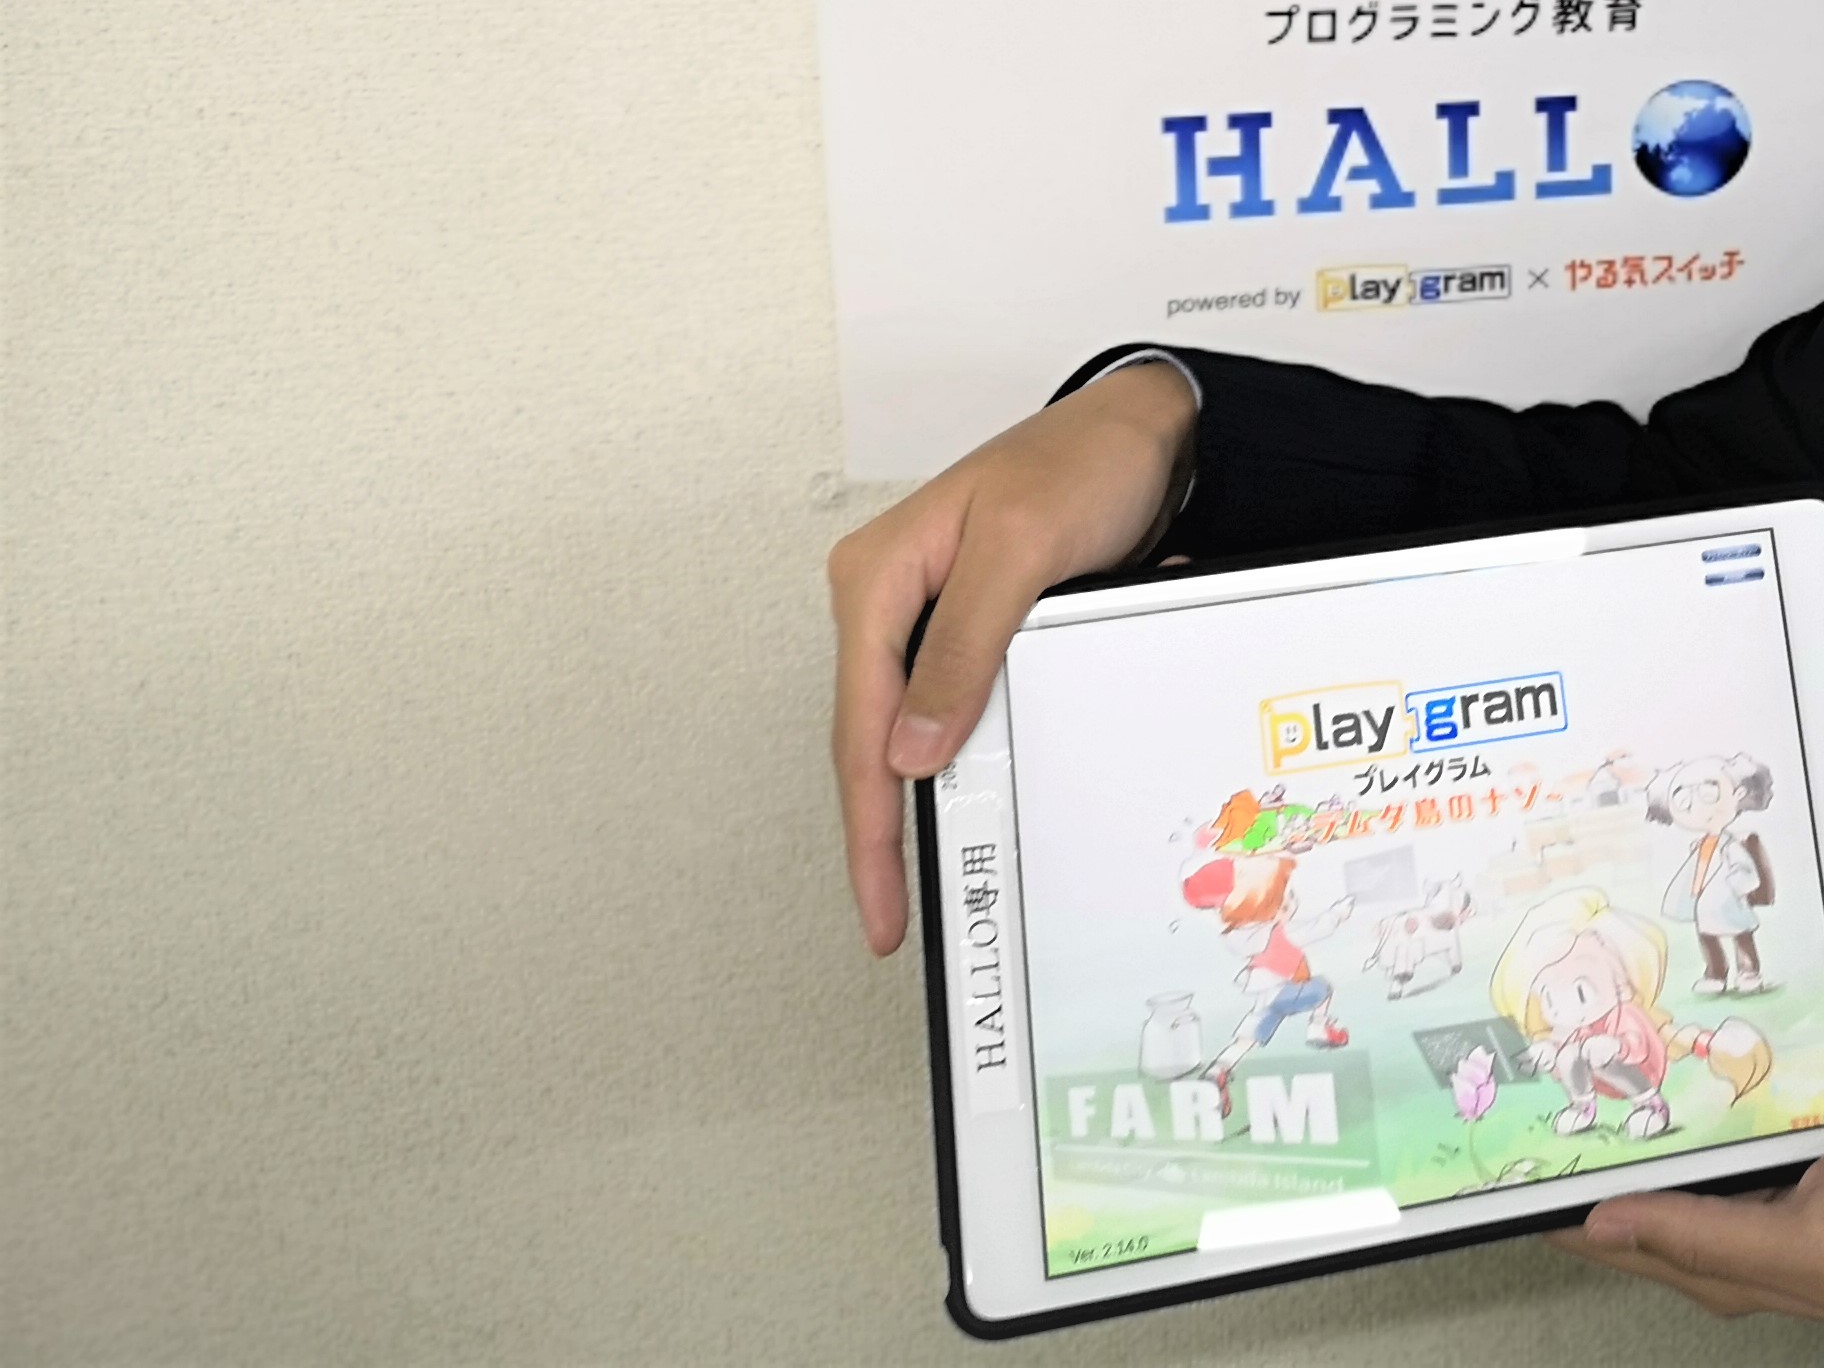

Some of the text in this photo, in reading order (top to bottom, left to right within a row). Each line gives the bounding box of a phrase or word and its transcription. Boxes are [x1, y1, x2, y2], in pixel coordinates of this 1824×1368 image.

[1565, 250, 1745, 292] やる気スイッチ
[1167, 290, 1266, 319] powered
[1274, 288, 1303, 308] by
[1353, 754, 1492, 797] プレイグラム
[1067, 1072, 1340, 1145] FARM
